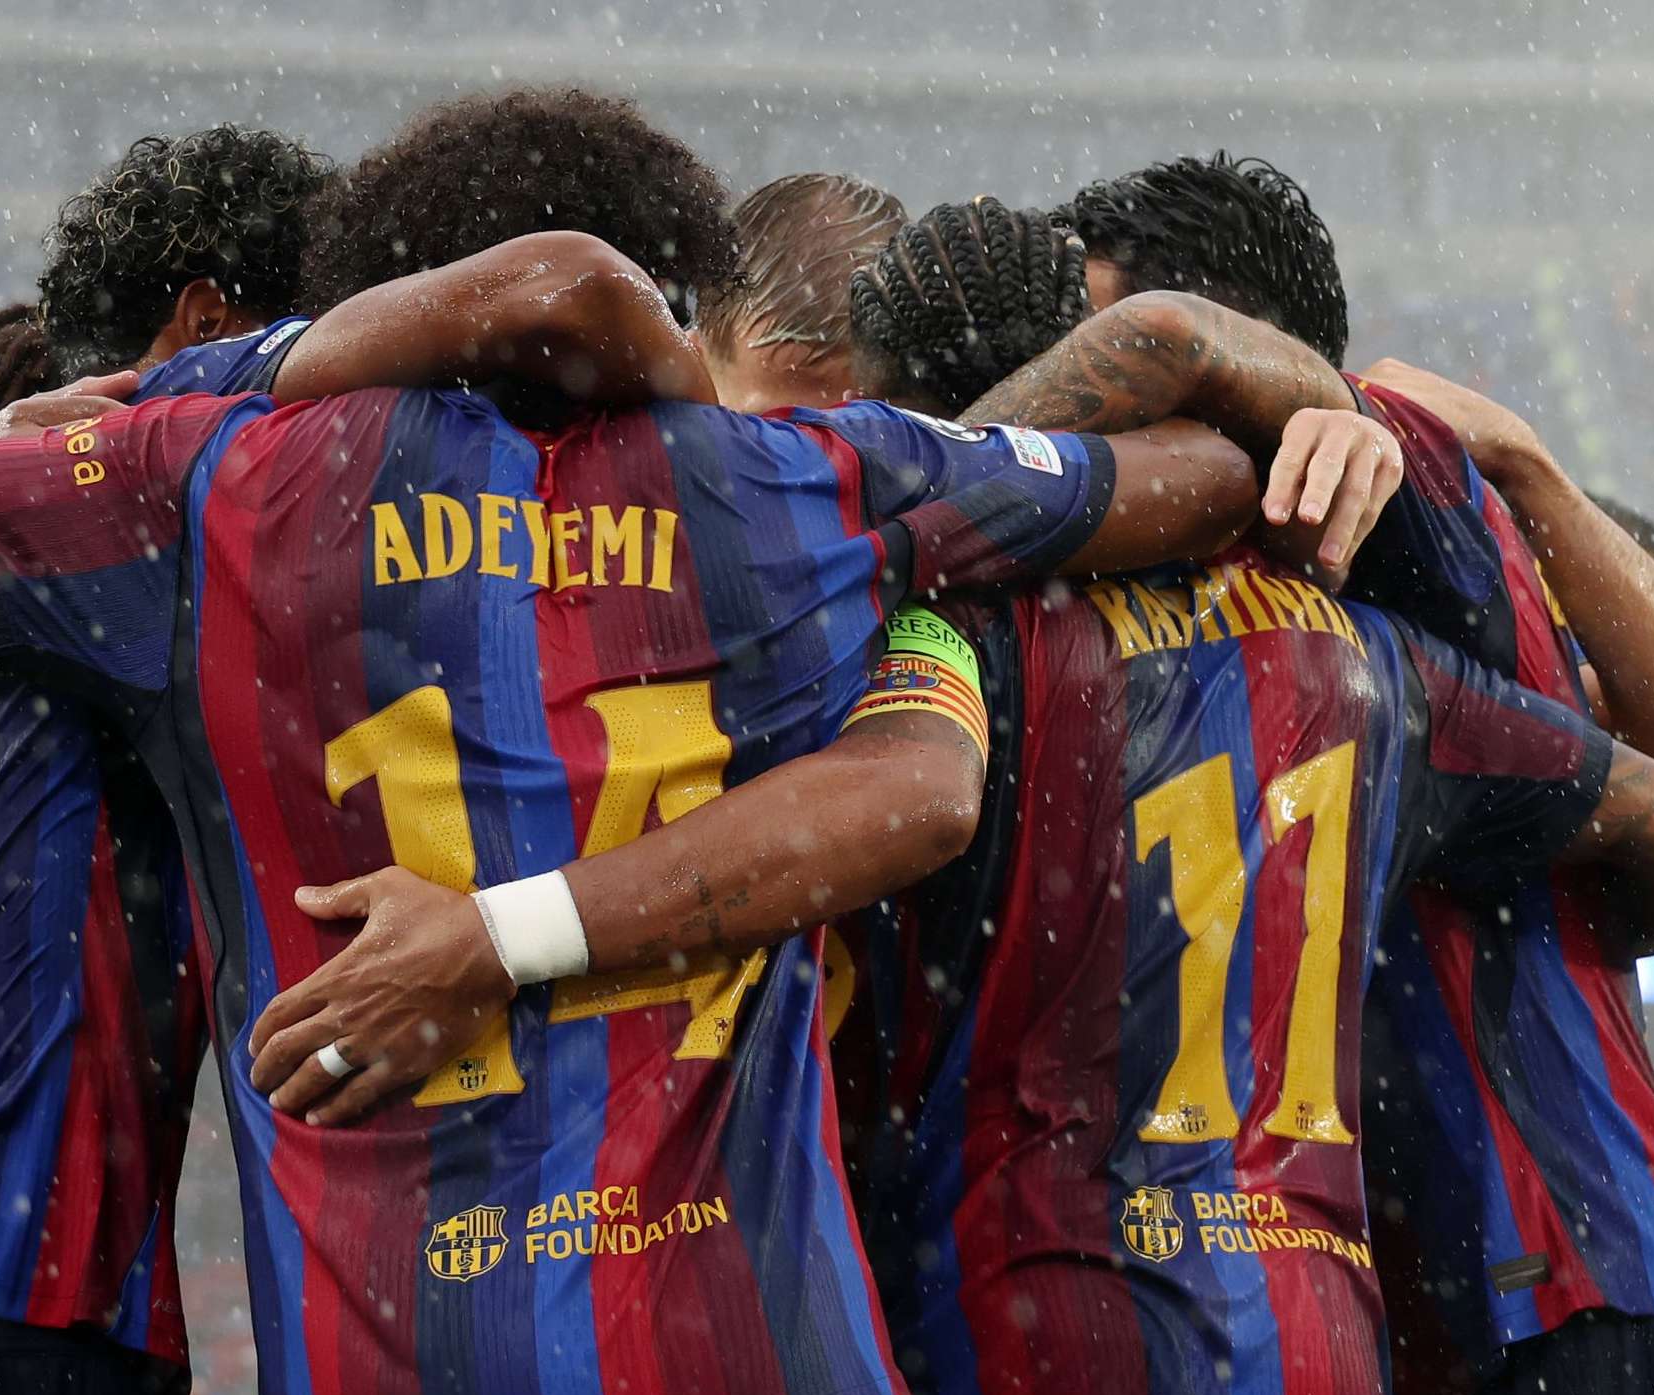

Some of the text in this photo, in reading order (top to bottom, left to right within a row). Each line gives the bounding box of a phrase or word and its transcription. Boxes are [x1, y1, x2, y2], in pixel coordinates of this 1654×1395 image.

[369, 492, 679, 594] ADEYEMI
[887, 618, 976, 666] RESPEC
[324, 680, 768, 1108] 14
[1134, 740, 1356, 1144] 11
[525, 1185, 639, 1230] BARÇA
[525, 1196, 729, 1264] FOUNDATION
[1191, 1192, 1289, 1227] BARÇA
[451, 1238, 482, 1249] FCB
[1199, 1224, 1372, 1269] FOUNDATION
